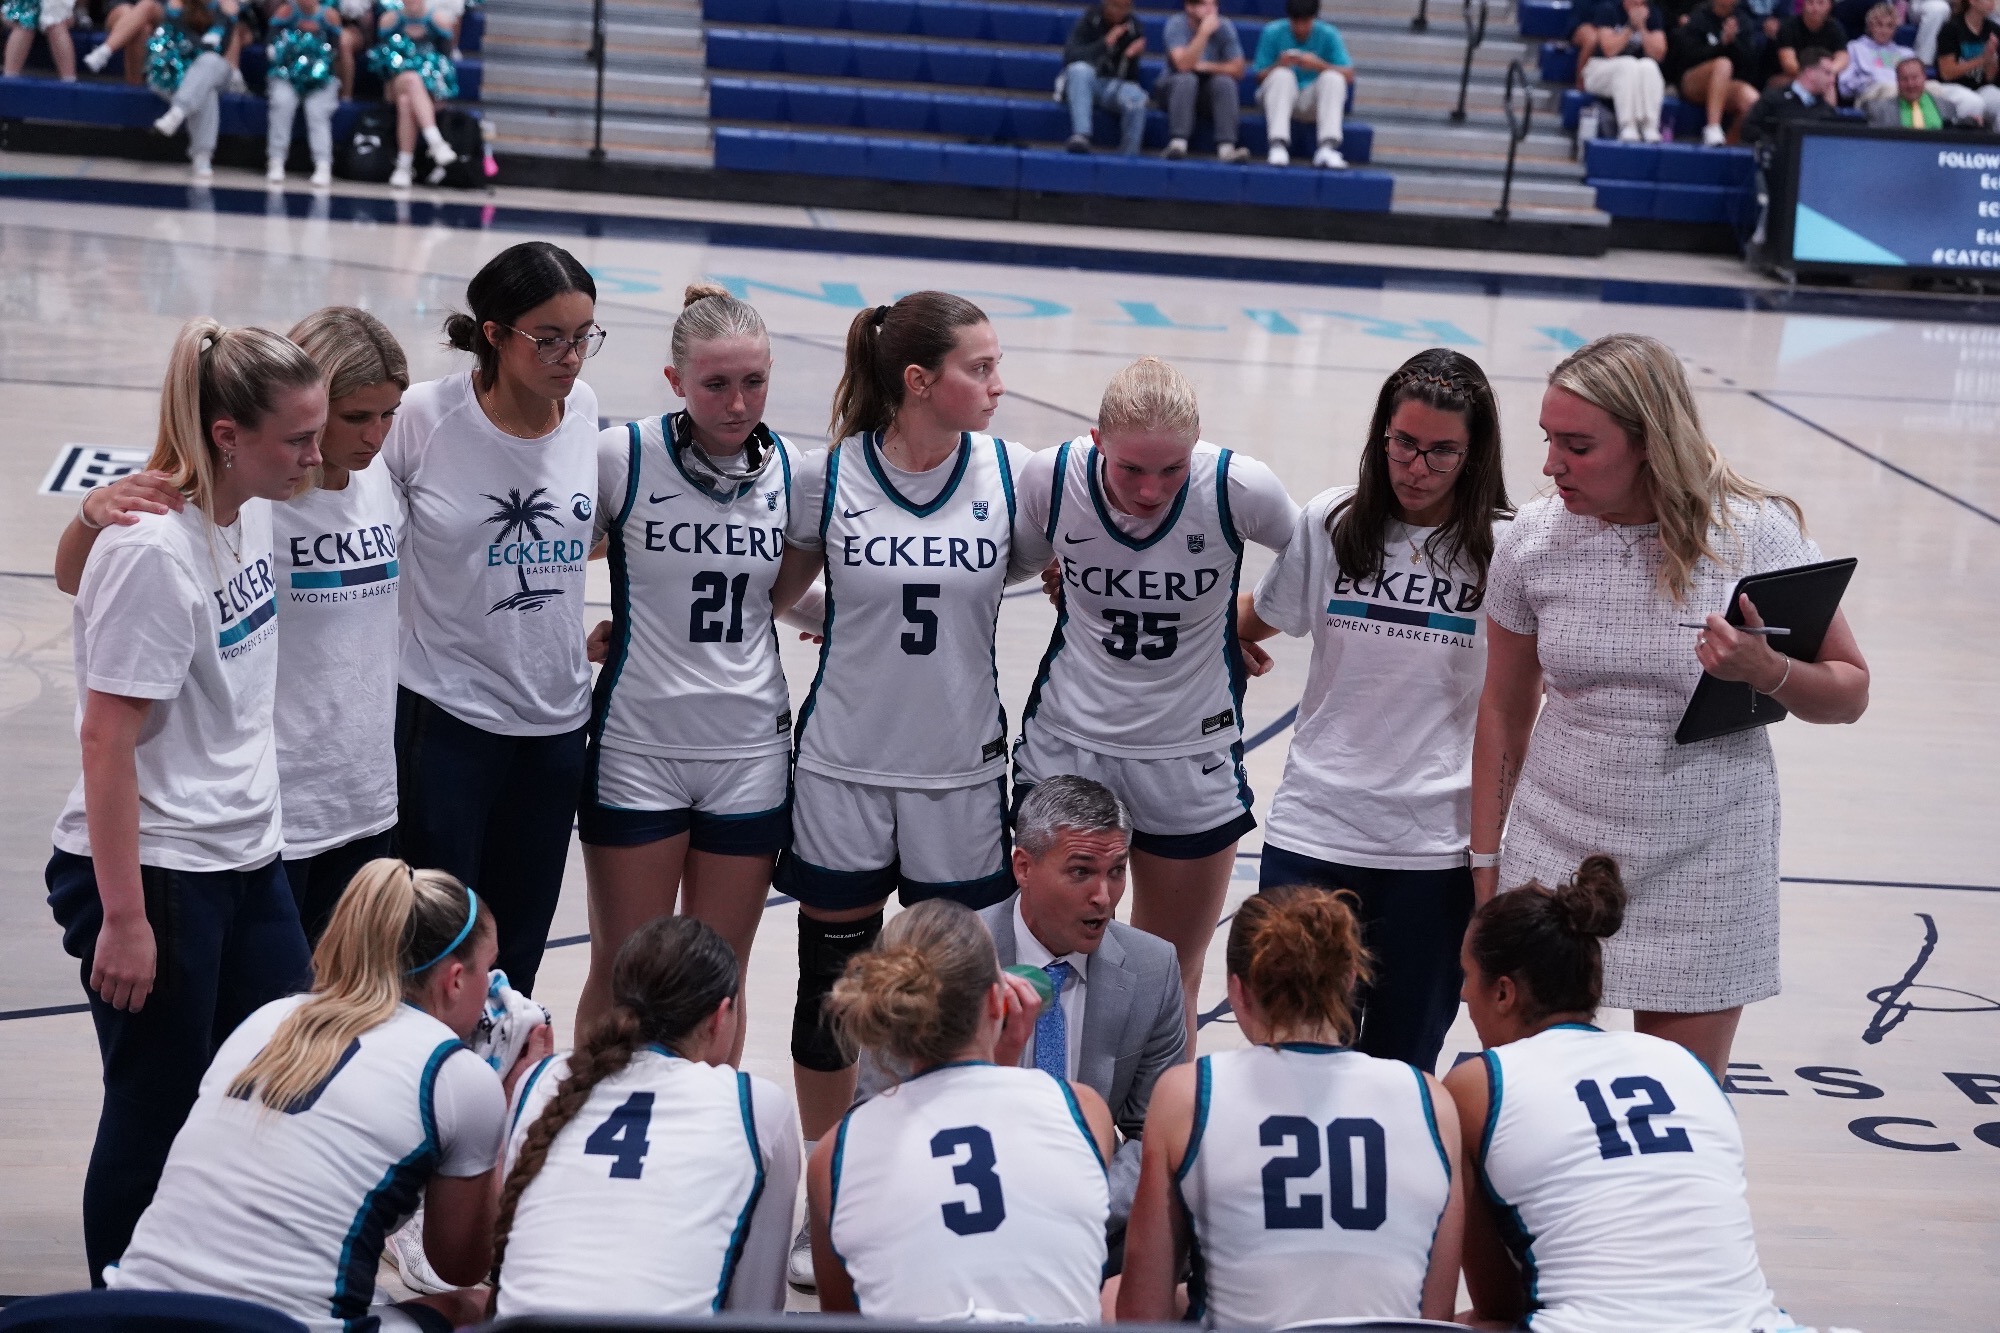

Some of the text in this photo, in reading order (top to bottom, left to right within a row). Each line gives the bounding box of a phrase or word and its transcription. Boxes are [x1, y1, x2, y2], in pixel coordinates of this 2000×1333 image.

[290, 524, 396, 567] ECKERD
[487, 539, 584, 567] ECKERD
[645, 521, 784, 562] ECKERD
[843, 535, 998, 573] ECKERD
[526, 564, 584, 575] BASKETBALL
[1063, 555, 1220, 602] ECKERD
[1334, 569, 1487, 614] ECKERD
[290, 590, 357, 603] WOMEN'S
[689, 570, 750, 643] 21
[900, 583, 941, 656] 5
[1101, 608, 1181, 661] 35
[1326, 617, 1474, 649] WOMEN'S BASKETBALL
[218, 633, 261, 660] WOMEN'S
[583, 1091, 656, 1180] 4
[1574, 1075, 1694, 1160] 12
[930, 1124, 1007, 1237] 3
[1259, 1114, 1388, 1231] 20
